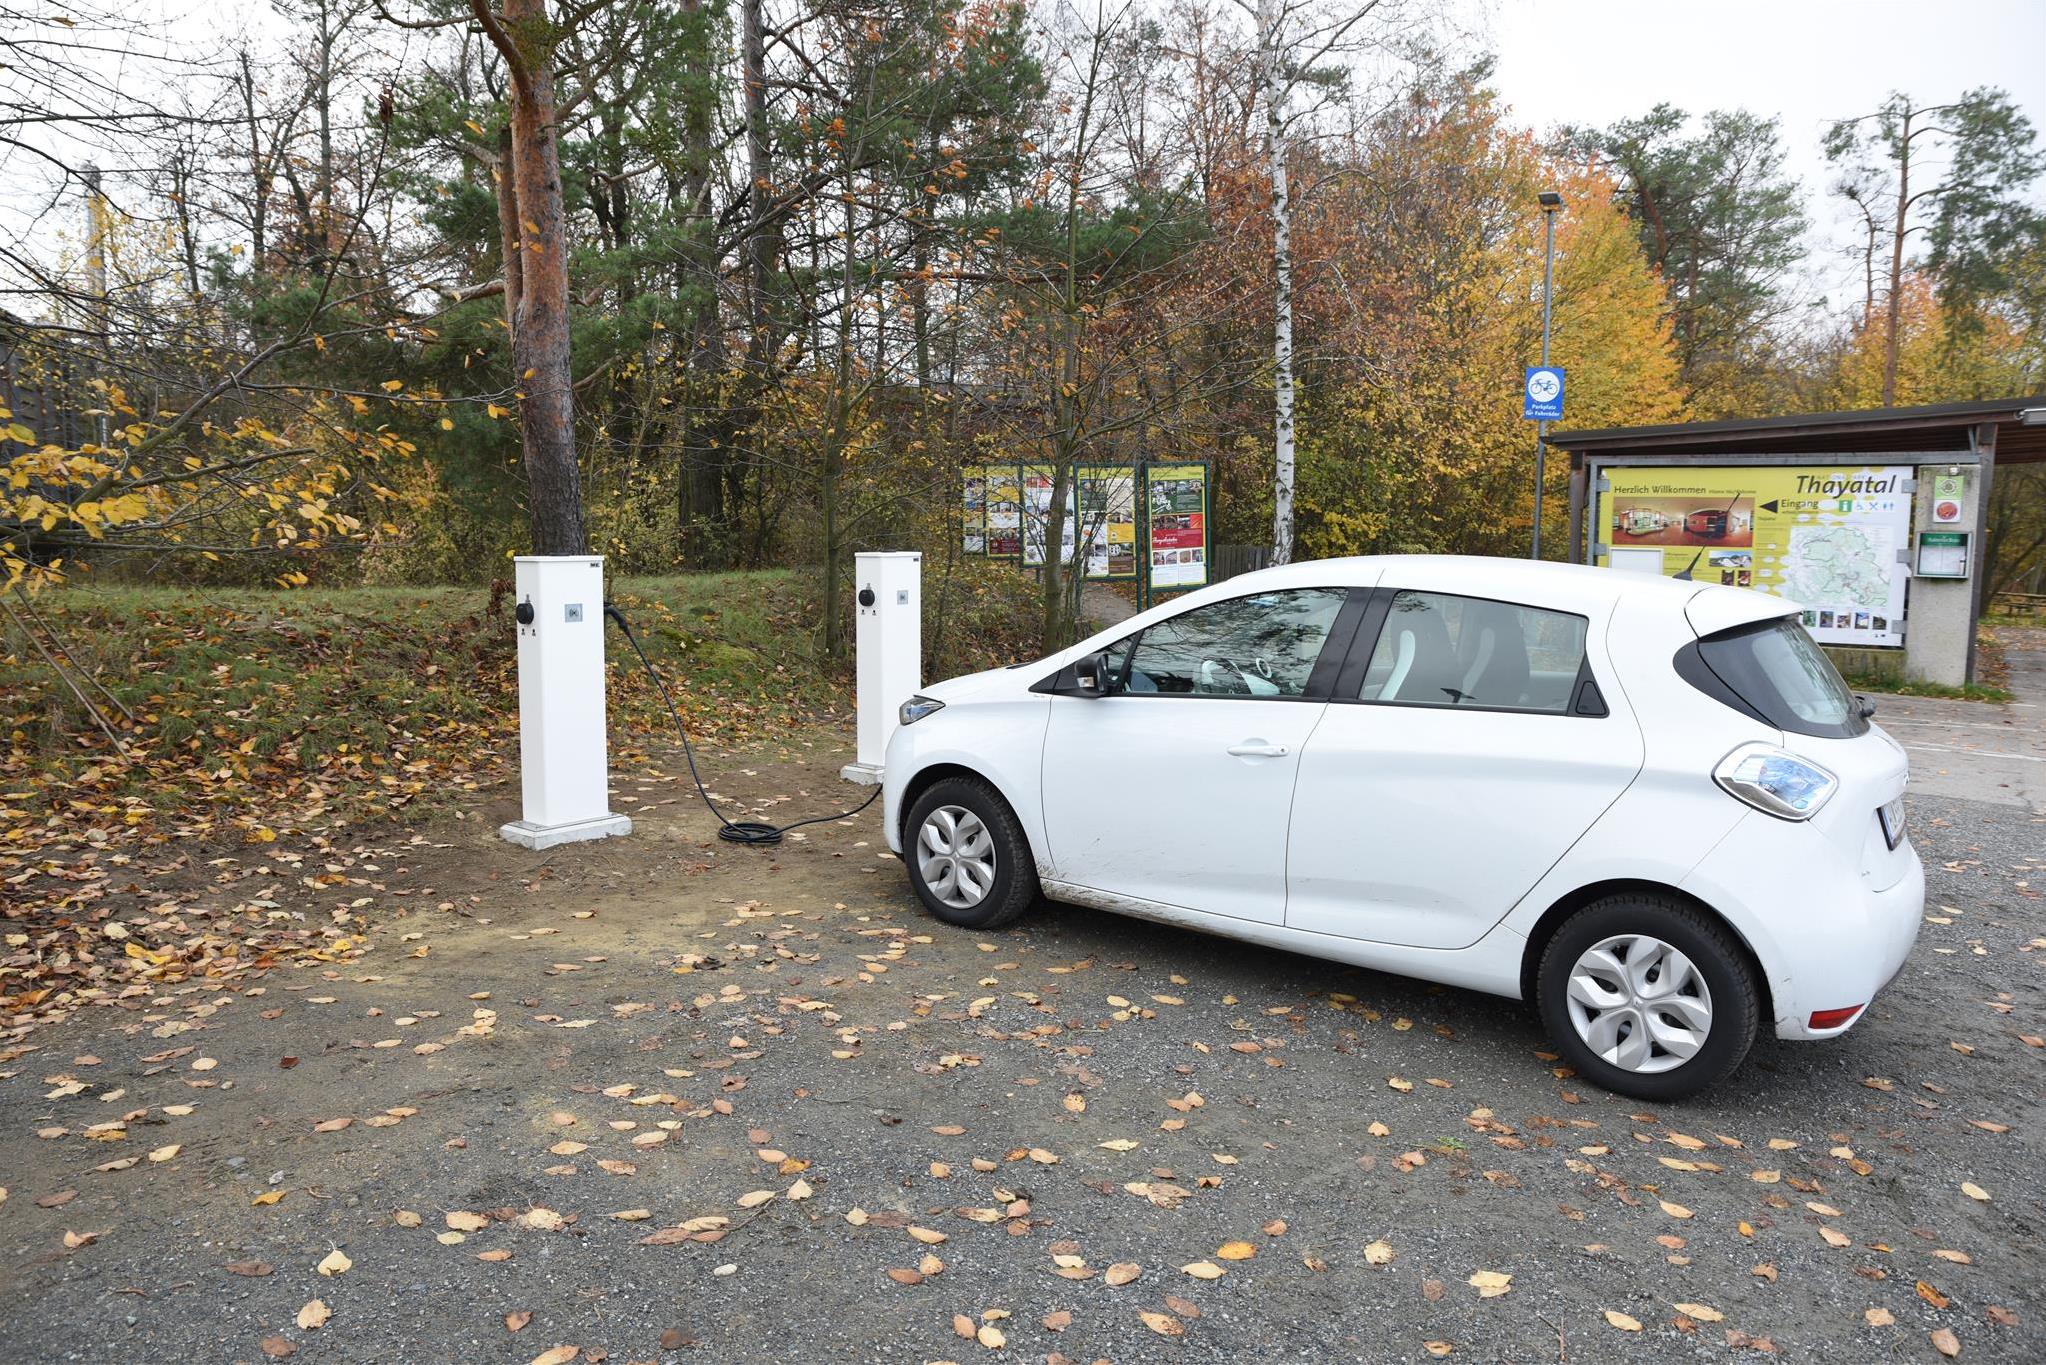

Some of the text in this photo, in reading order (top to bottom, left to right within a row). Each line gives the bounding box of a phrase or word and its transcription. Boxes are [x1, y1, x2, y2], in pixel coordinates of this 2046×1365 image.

[1614, 485, 1649, 494] Herzlich
[1652, 485, 1706, 494] Willkommen
[1797, 475, 1896, 499] Thayatal
[1781, 500, 1818, 510] Eingang
